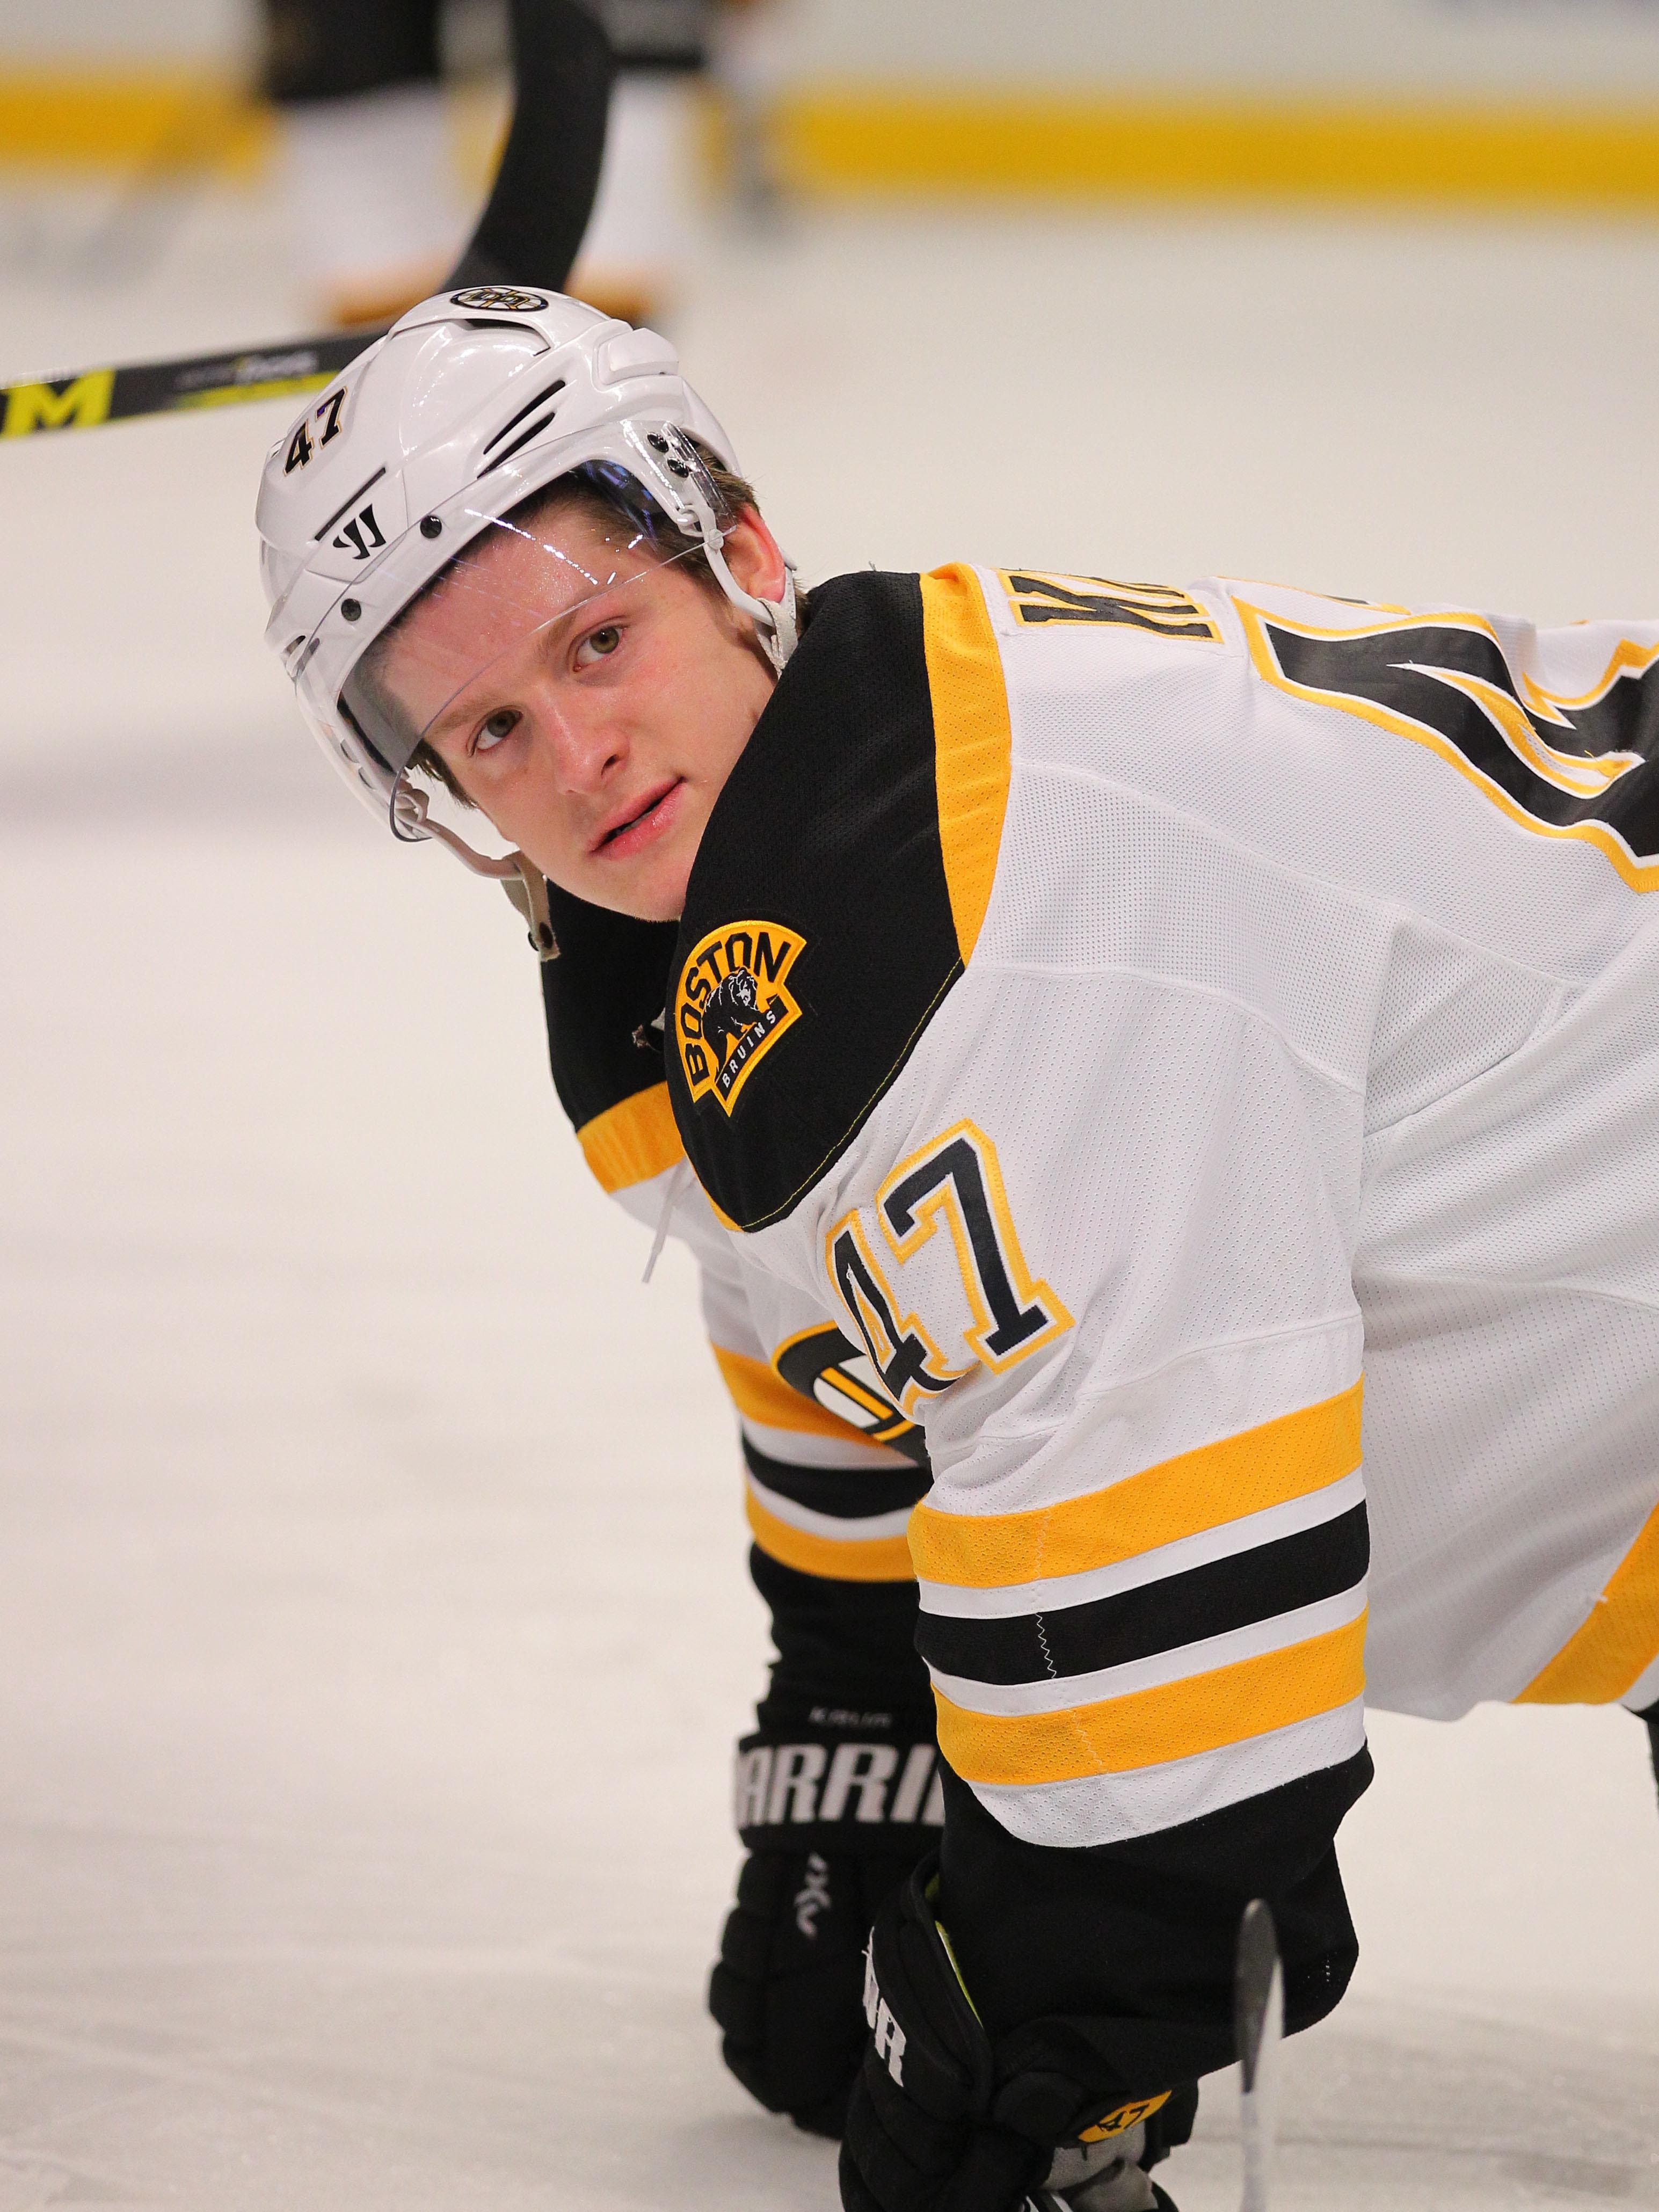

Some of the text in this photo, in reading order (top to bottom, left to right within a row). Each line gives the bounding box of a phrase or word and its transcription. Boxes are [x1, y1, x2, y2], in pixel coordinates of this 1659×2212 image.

[283, 386, 347, 477] 47
[681, 932, 791, 1086] BOSTON
[722, 1010, 776, 1088] BRUINS
[825, 1118, 1076, 1416] 47
[734, 1743, 946, 1827] ARRI
[1100, 2104, 1149, 2131] 47
